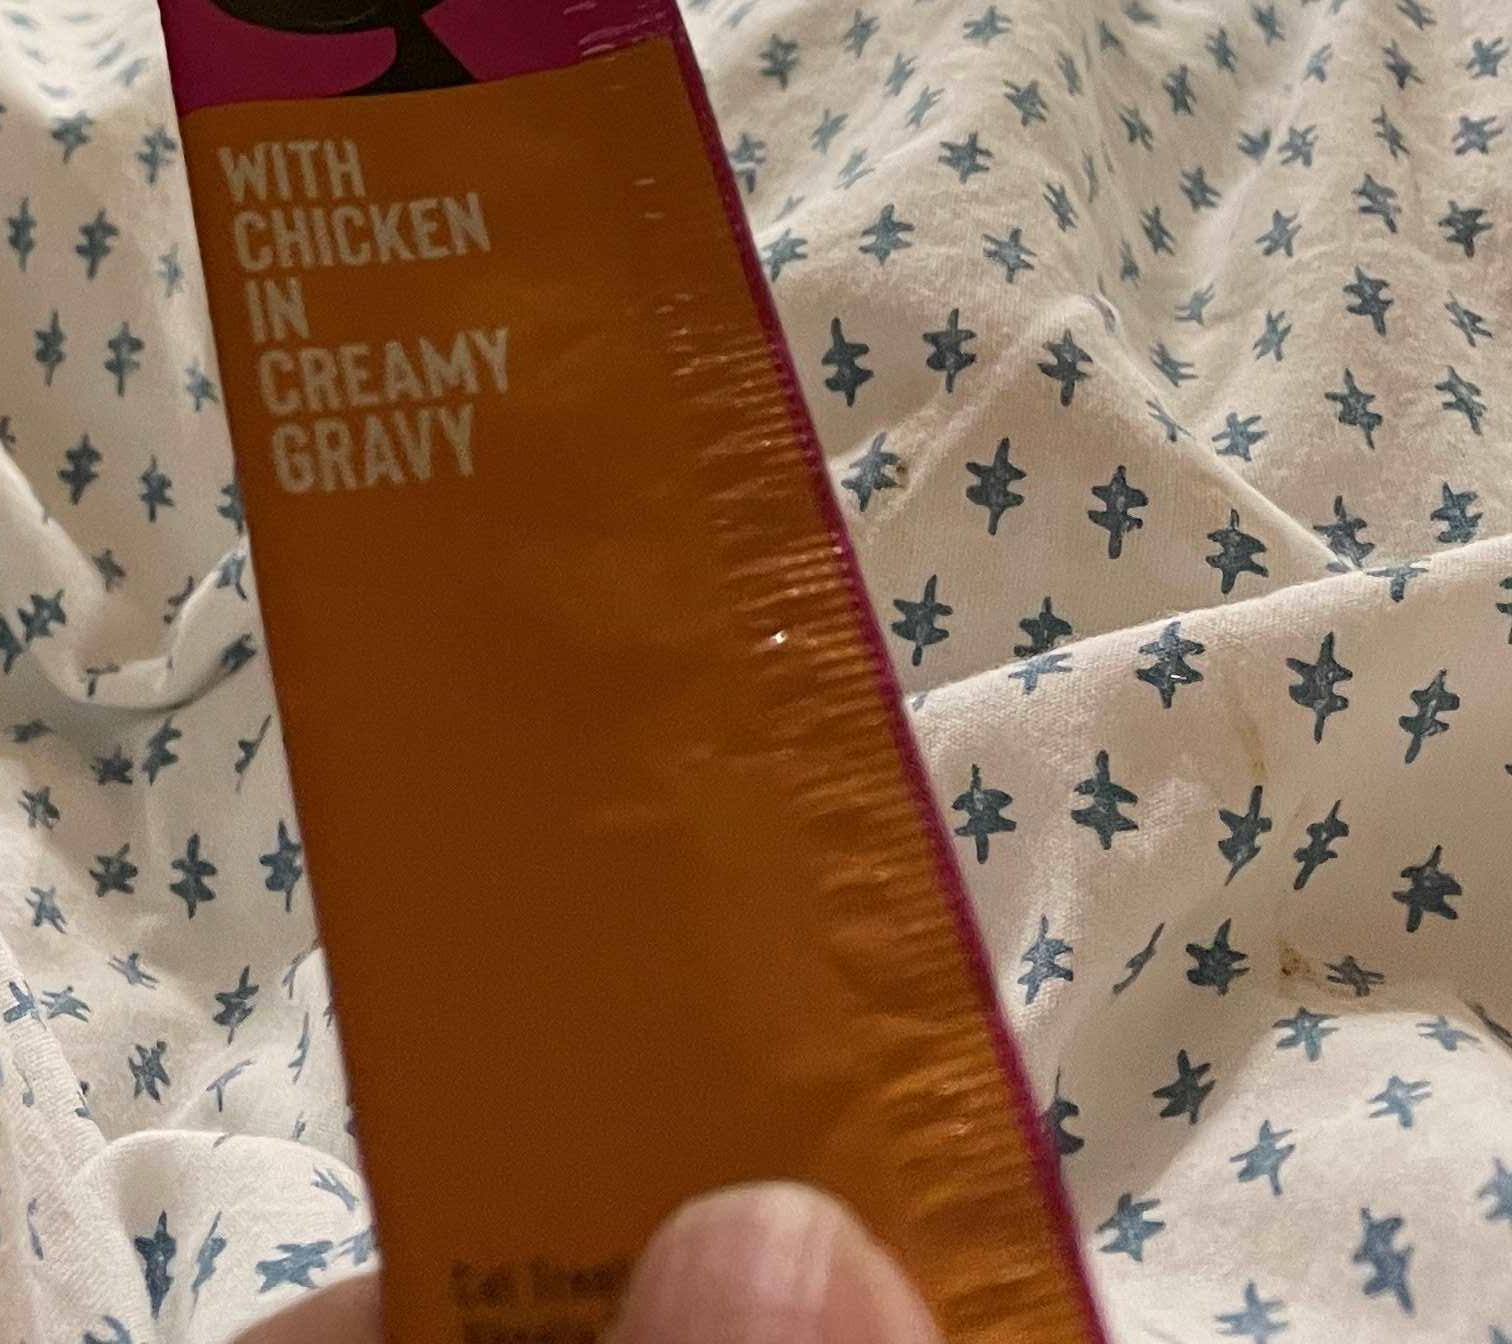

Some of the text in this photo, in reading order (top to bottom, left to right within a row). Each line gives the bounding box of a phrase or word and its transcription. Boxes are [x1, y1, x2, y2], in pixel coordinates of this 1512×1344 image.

[217, 135, 367, 204] WITH
[232, 191, 492, 273] CHICKEN
[244, 276, 310, 344] IN
[257, 325, 510, 418] CREAMY
[271, 402, 476, 495] GRAVY
